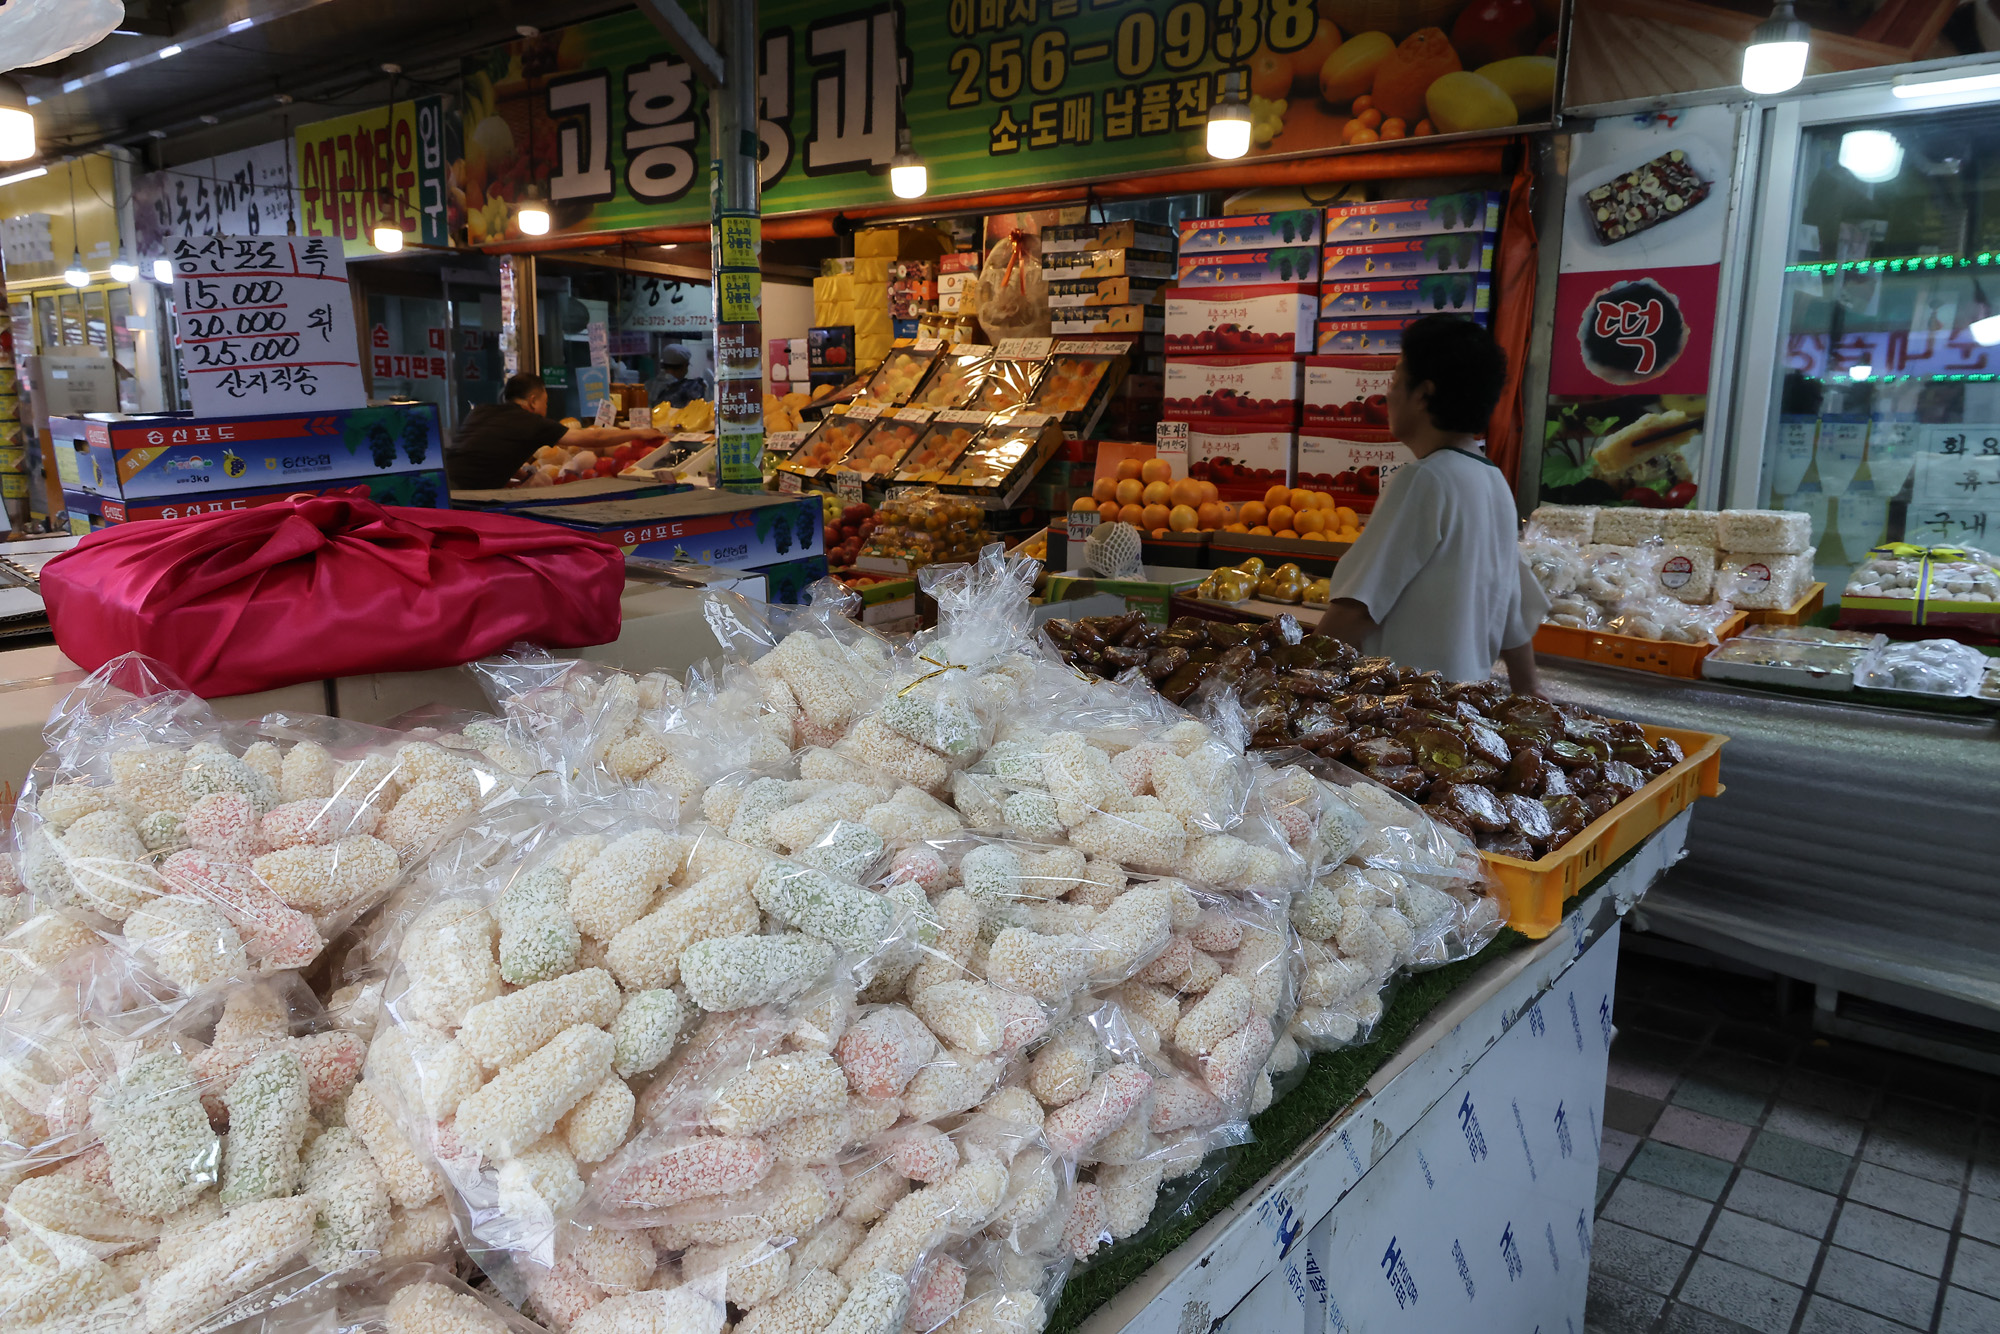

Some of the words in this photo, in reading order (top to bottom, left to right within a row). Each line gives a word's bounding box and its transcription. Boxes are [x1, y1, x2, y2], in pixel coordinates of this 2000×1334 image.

[949, 0, 1315, 106] 256-0938
[419, 106, 443, 238] 입구
[726, 239, 752, 249] 상품권
[727, 227, 751, 236] 온누리
[173, 238, 284, 272] 송산포도
[301, 239, 328, 279] 특
[725, 282, 750, 292] 온누리
[725, 293, 751, 304] 상품권
[307, 303, 333, 343] 원
[1595, 298, 1663, 374] 떡
[719, 336, 744, 348] 온누리
[216, 365, 318, 398] 산지직송
[374, 354, 447, 380] 돼지편육
[721, 392, 747, 403] 온누리
[147, 426, 235, 445] 송산포도
[722, 442, 750, 452] 온누리
[190, 474, 210, 484] 3kg
[623, 523, 683, 544] 송산포도
[1465, 1125, 1478, 1163] STEEL
[1470, 1112, 1488, 1160] HYUNDAI
[1390, 1271, 1407, 1310] STEEL
[1397, 1256, 1418, 1306] HYUNDAI
